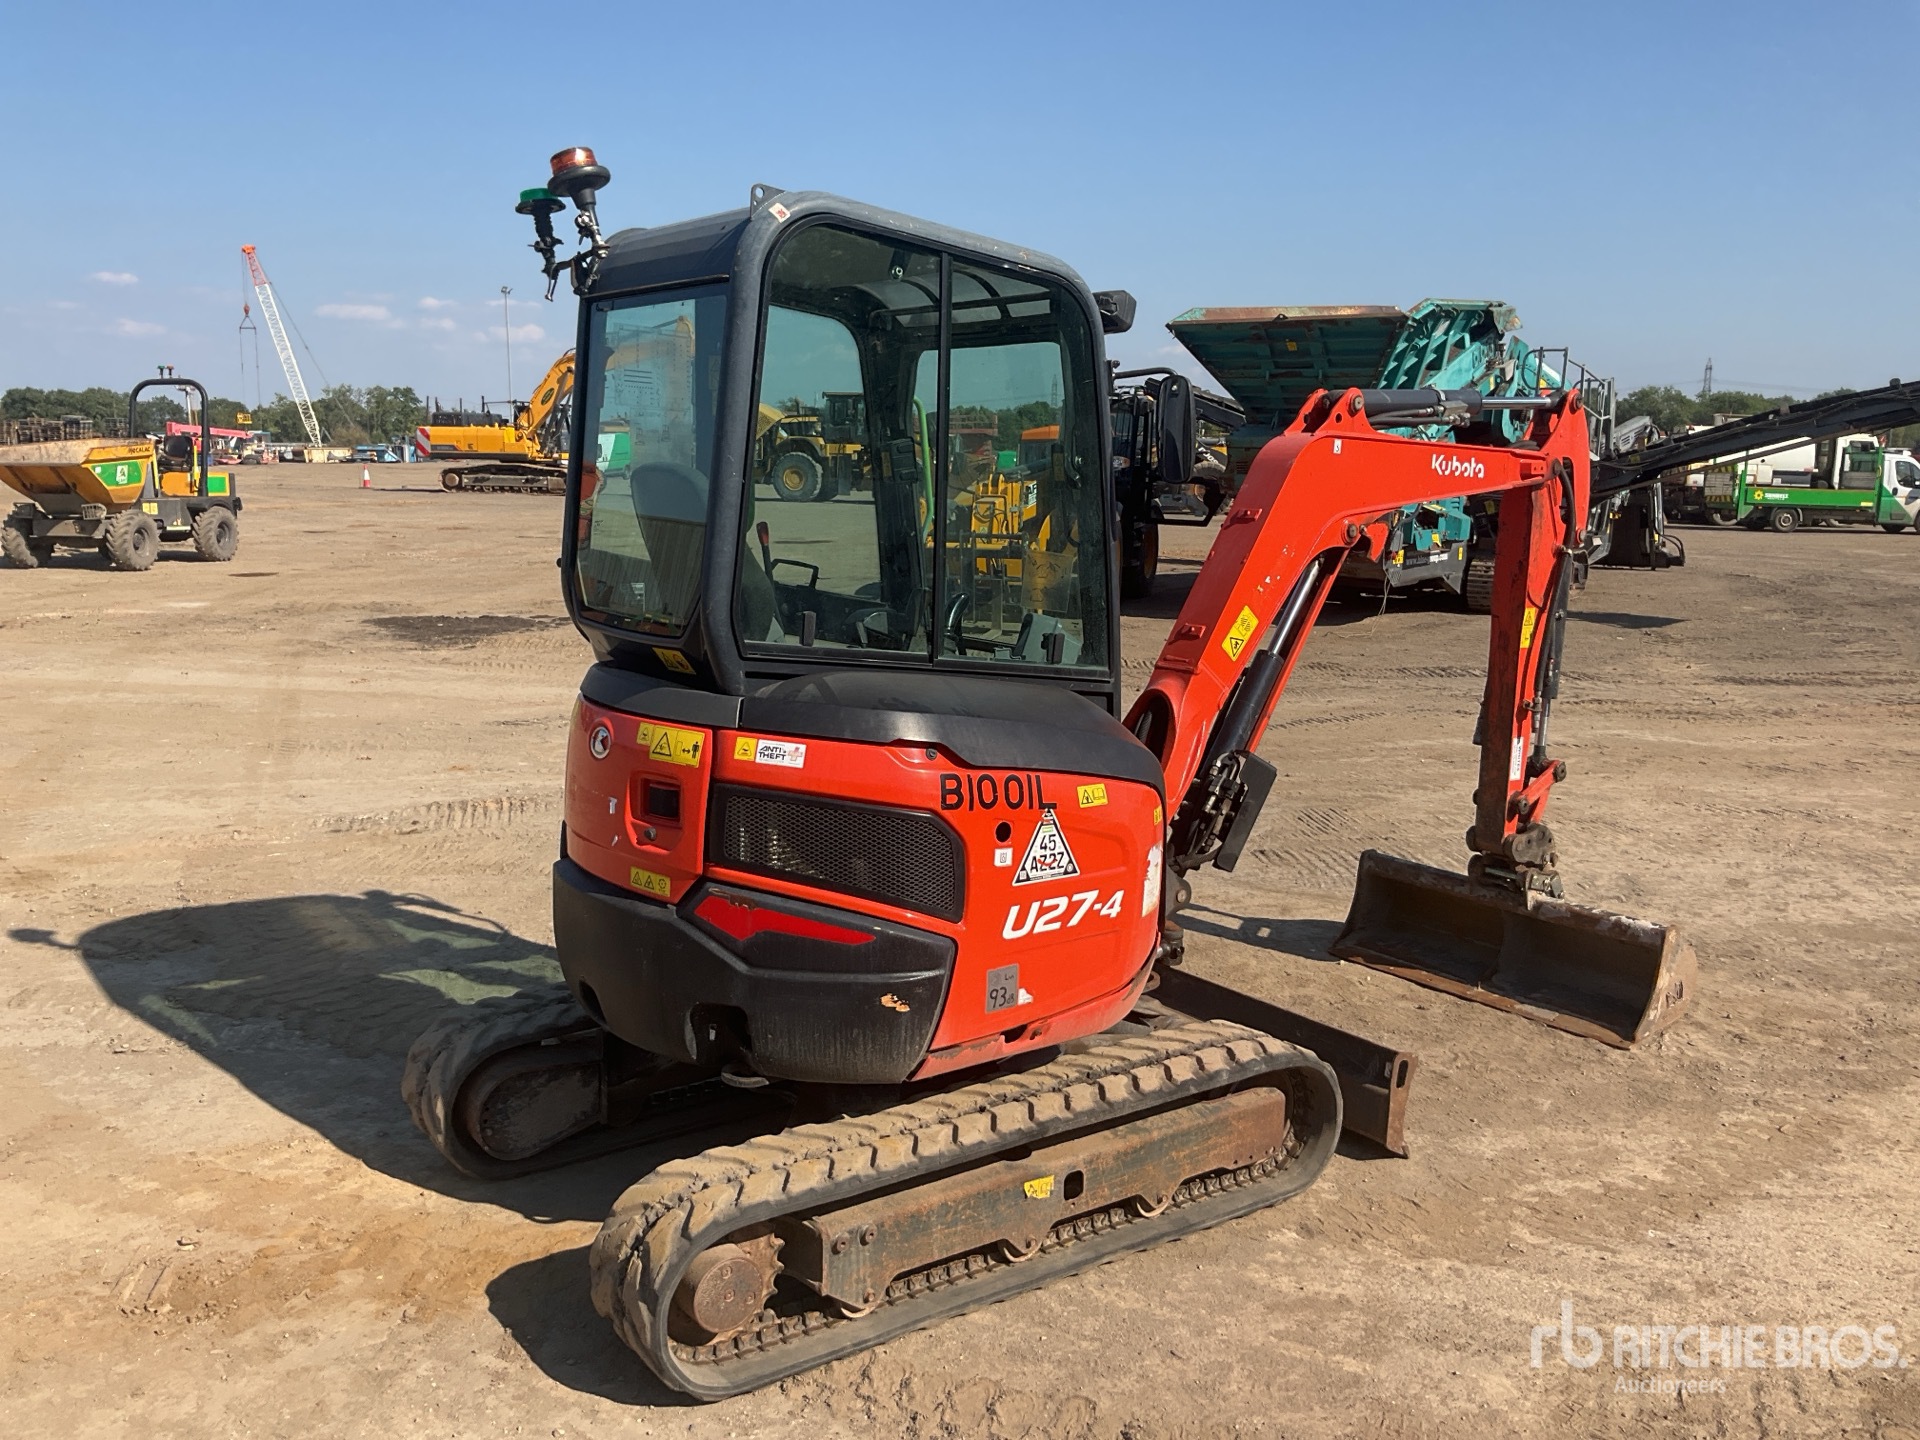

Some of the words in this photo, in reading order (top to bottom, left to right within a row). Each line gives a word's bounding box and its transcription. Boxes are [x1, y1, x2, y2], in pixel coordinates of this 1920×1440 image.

[1431, 453, 1485, 479] Kubota
[758, 751, 787, 761] THEFT
[1039, 833, 1057, 852] 45
[1002, 889, 1125, 940] U27-4
[989, 986, 1007, 1009] 93
